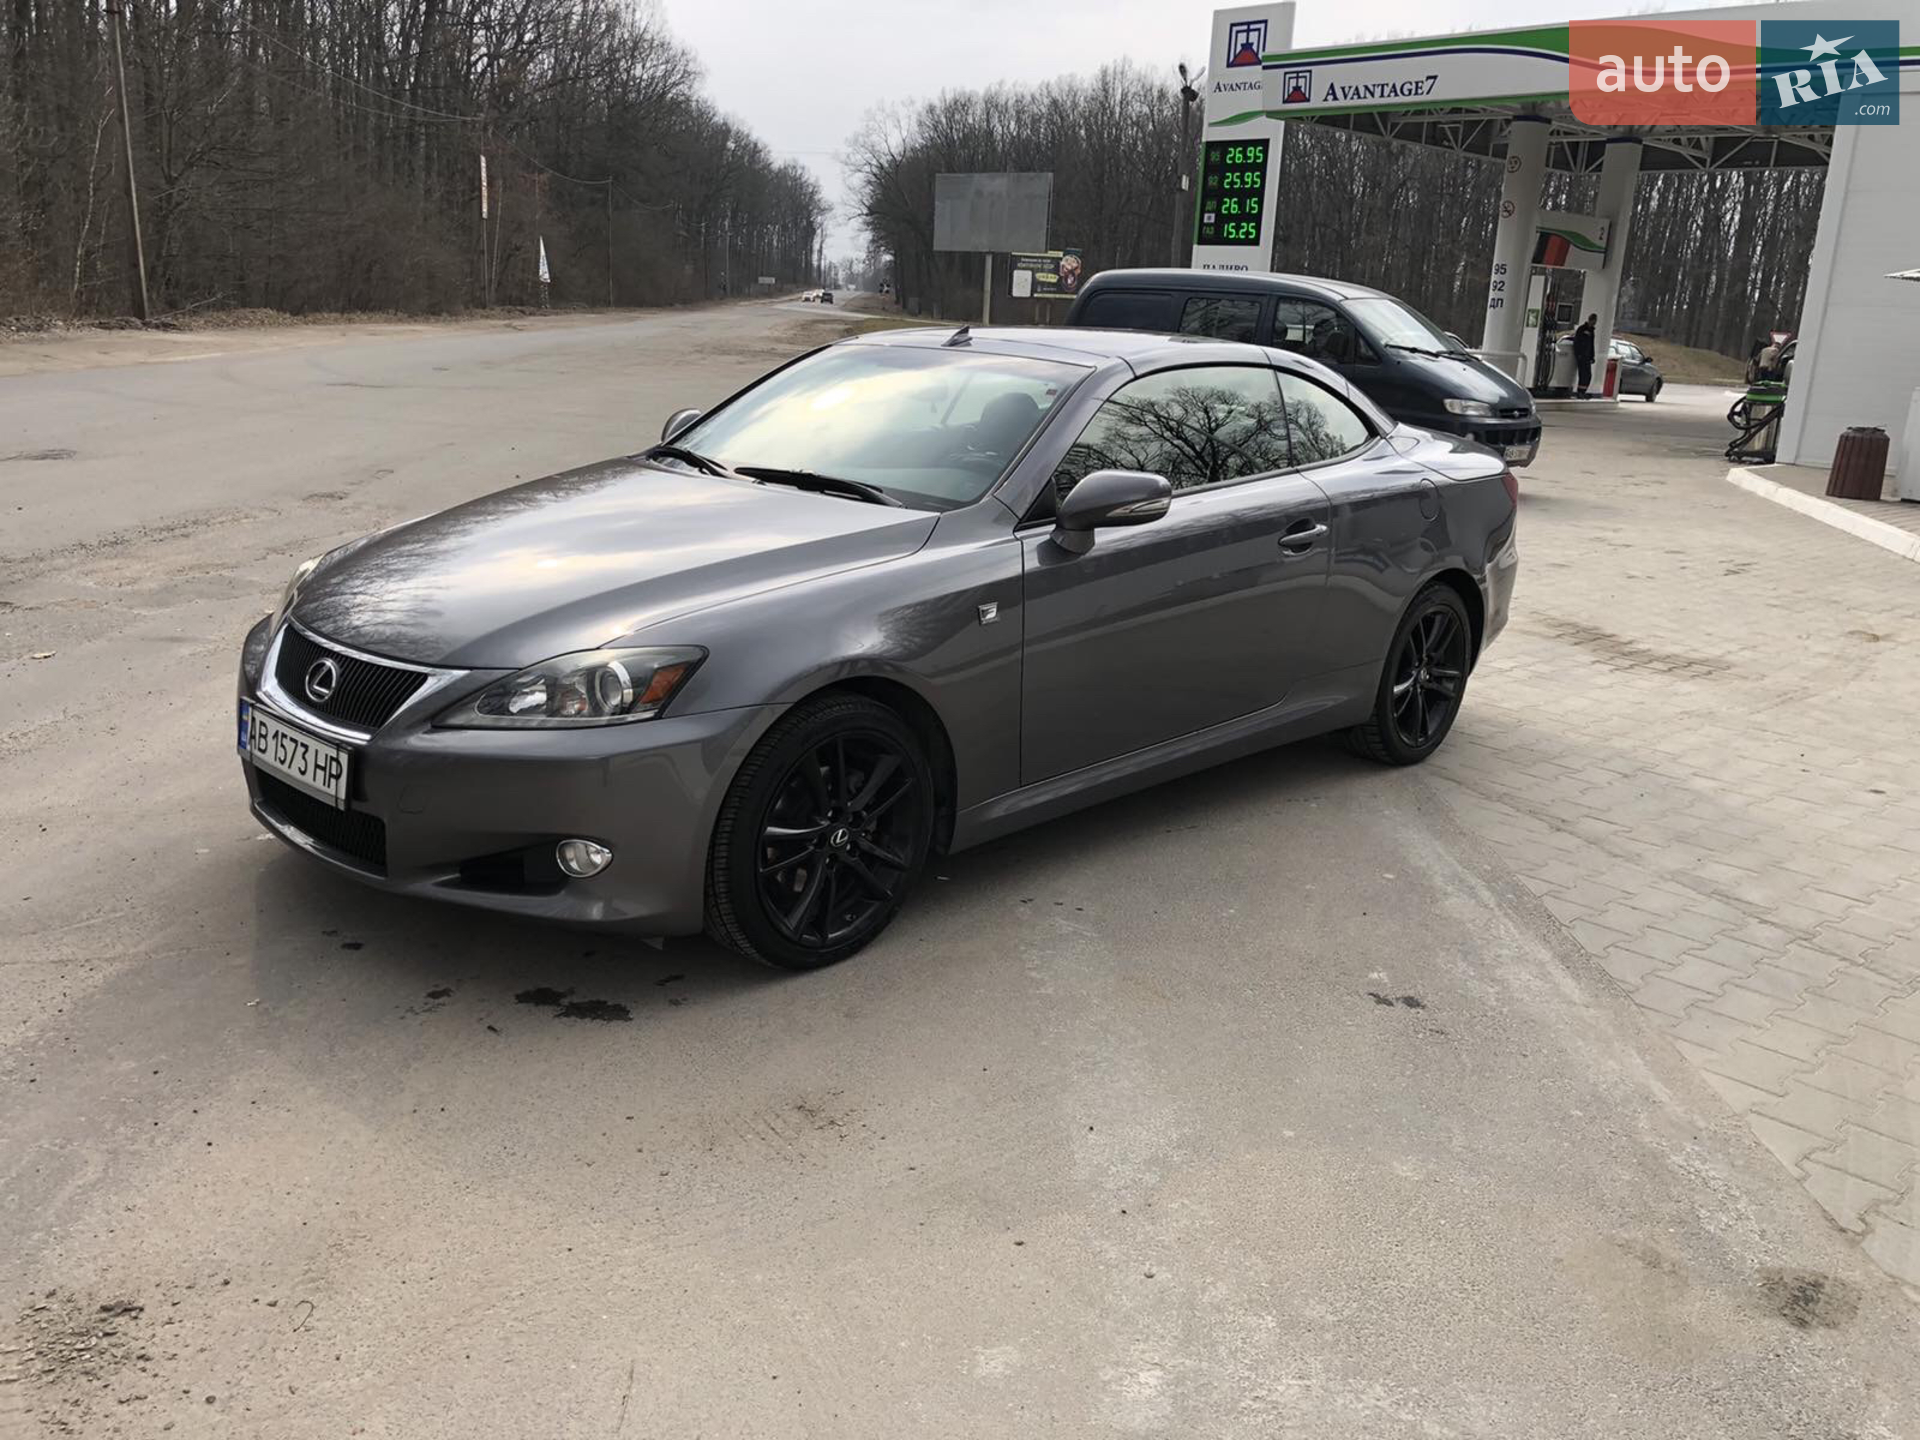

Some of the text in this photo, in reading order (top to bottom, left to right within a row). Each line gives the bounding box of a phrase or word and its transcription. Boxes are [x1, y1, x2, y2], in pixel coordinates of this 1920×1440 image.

[1213, 80, 1263, 93] AVANTAG
[1226, 146, 1264, 163] 26.95
[1223, 172, 1261, 188] 25.95
[1221, 198, 1259, 214] 26.15
[1223, 222, 1256, 239] 15.25
[1494, 263, 1507, 275] 95
[1492, 280, 1505, 292] 92
[250, 716, 269, 754] AB
[272, 729, 309, 776] 1573
[313, 749, 343, 789] HP
